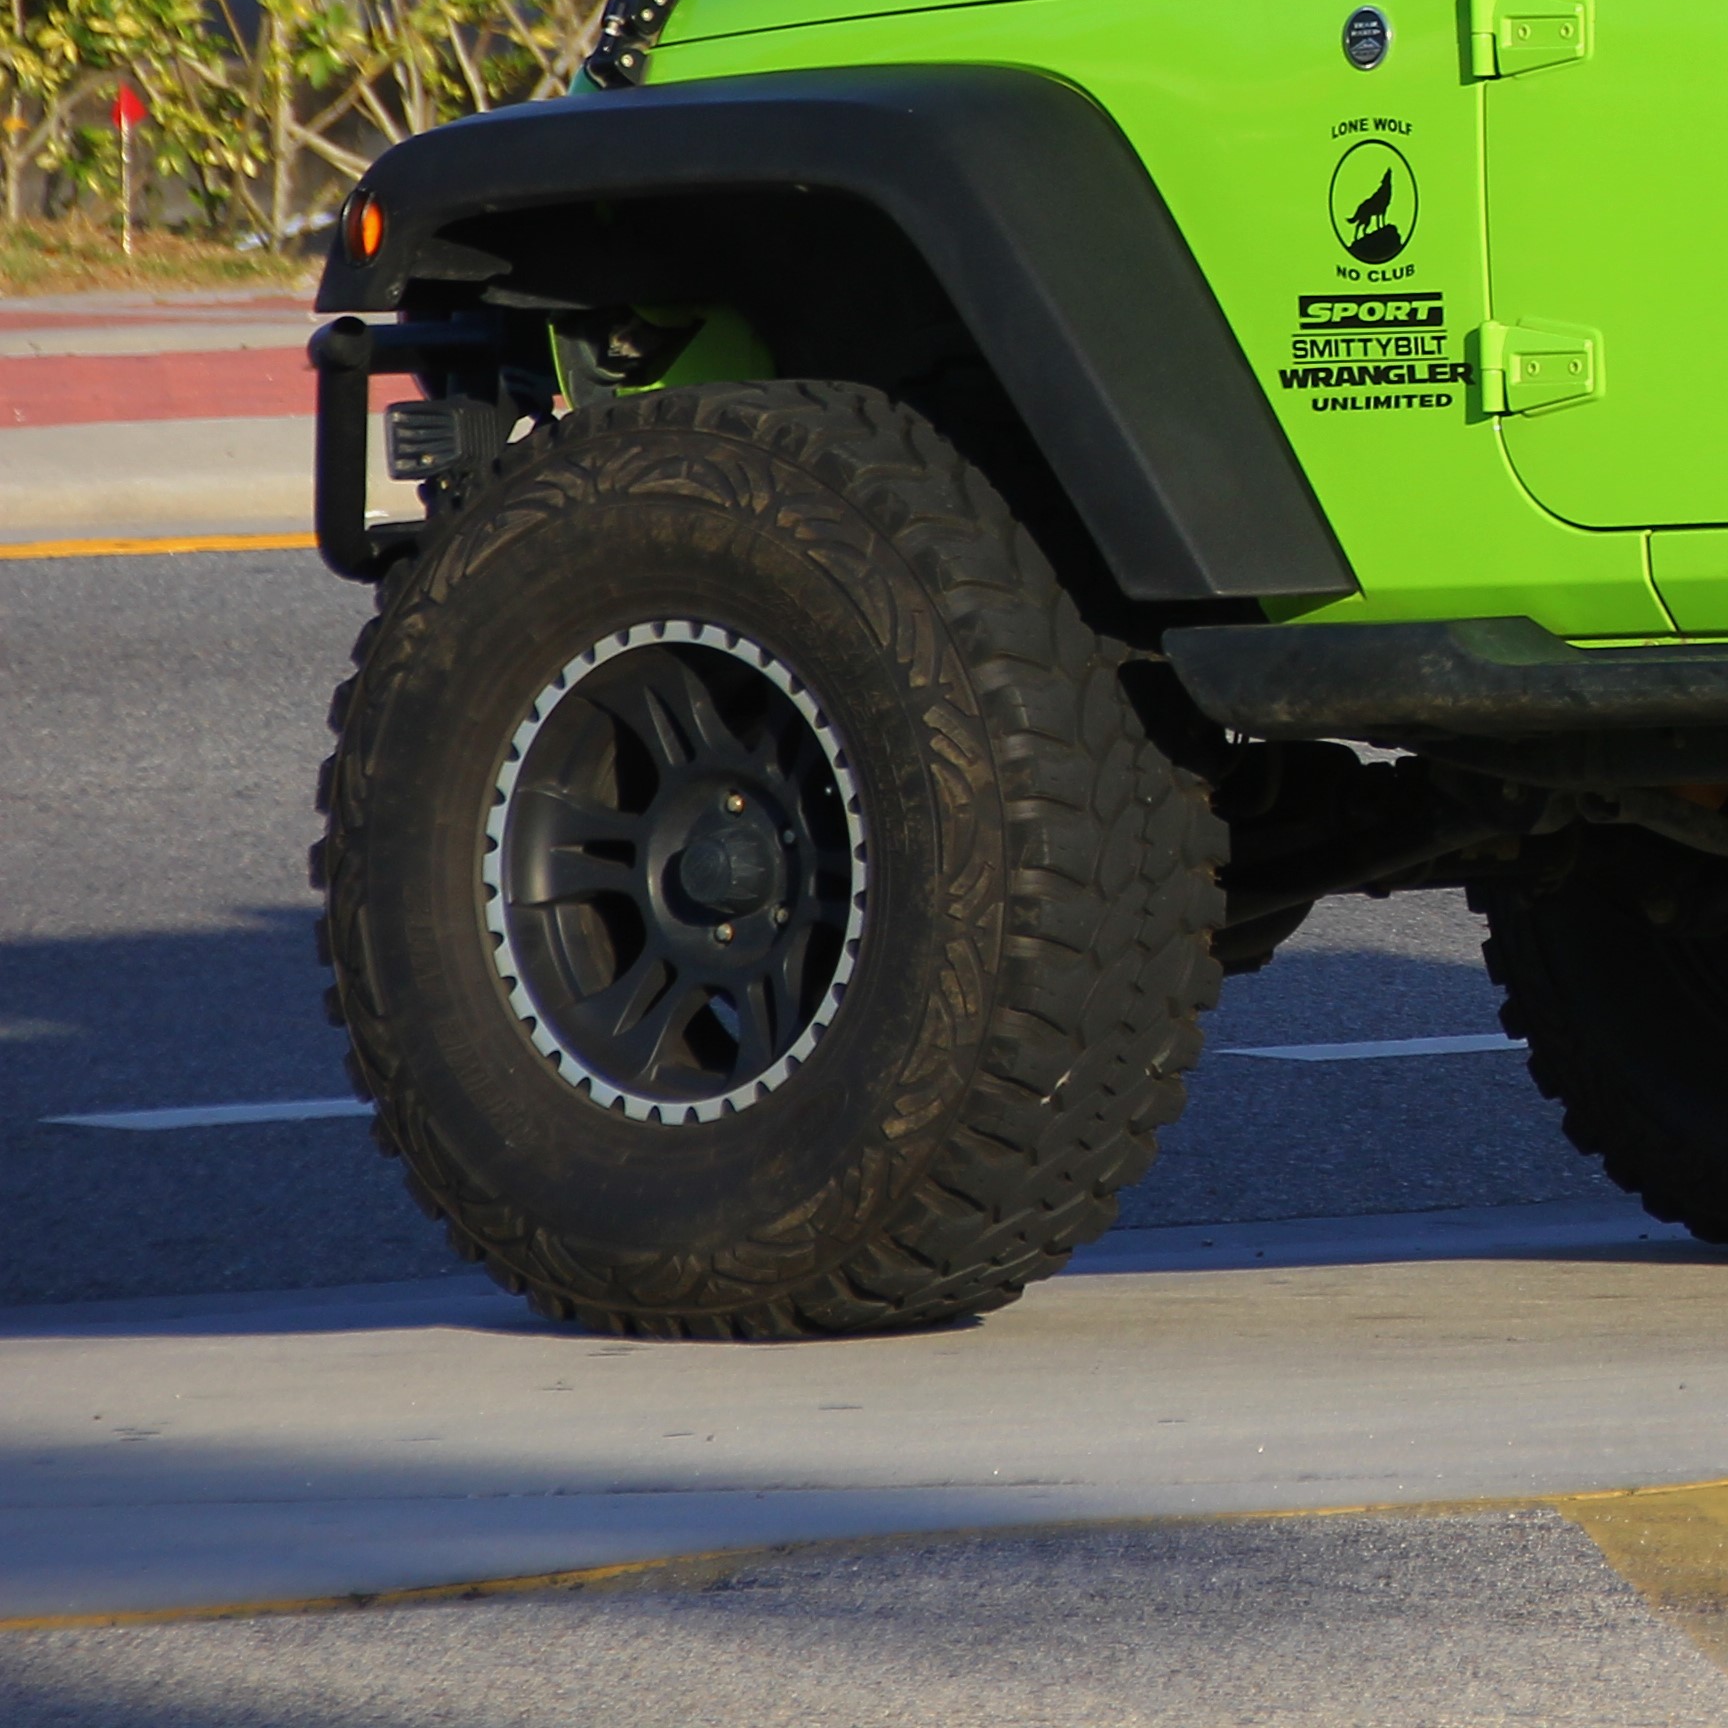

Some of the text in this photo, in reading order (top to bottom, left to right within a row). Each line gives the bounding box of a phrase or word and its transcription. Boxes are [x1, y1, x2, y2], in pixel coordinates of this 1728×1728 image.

[1331, 117, 1413, 139] LONE WOLF
[1336, 263, 1416, 282] NO CLUB
[1304, 300, 1442, 323] SPORT
[1292, 335, 1448, 360] SMITTYBILT
[1279, 362, 1476, 389] WRANGLER
[1311, 393, 1453, 412] UNLIMITED
